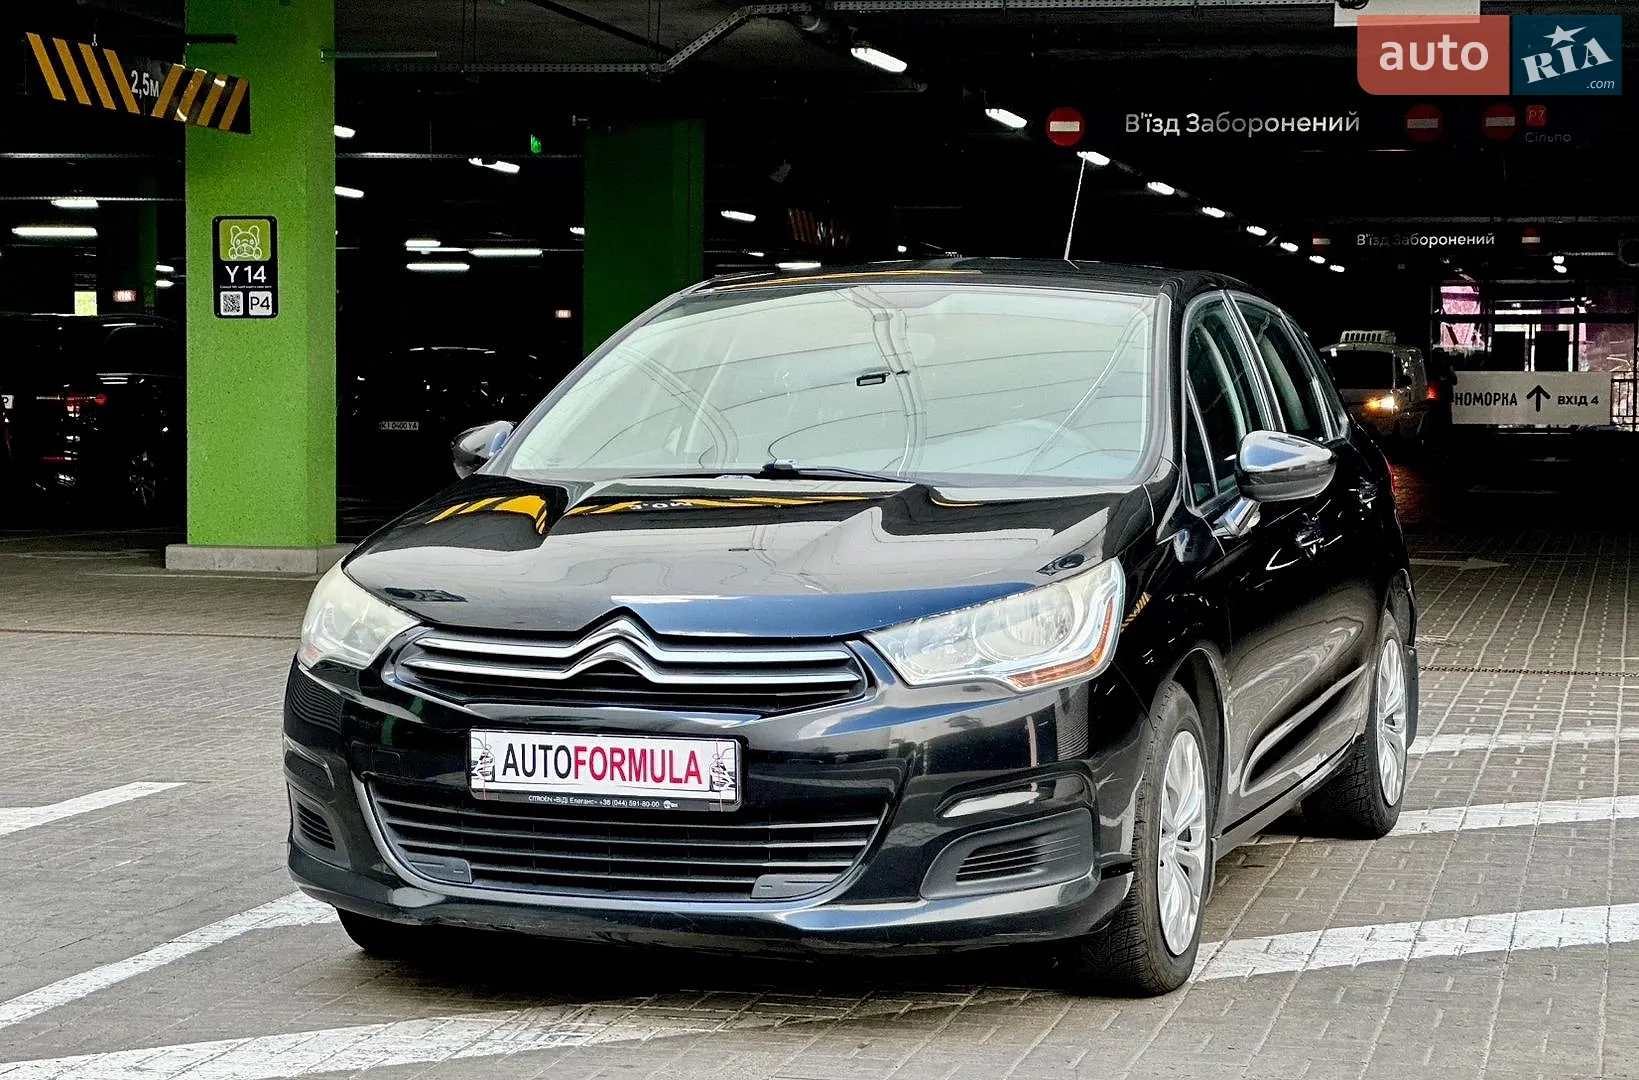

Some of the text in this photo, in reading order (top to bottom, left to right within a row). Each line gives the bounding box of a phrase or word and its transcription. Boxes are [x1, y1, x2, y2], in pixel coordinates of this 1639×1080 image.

[1125, 110, 1360, 138] В'їзд Заборонений
[1525, 132, 1572, 143] Сільпо
[1393, 232, 1495, 248] Заборонений
[225, 265, 266, 283] Y 14
[250, 296, 270, 310] P4
[1452, 392, 1518, 406] НОМОРКА
[1558, 395, 1599, 407] ВХІД 4
[502, 743, 703, 785] AUTOFORMULA
[611, 799, 628, 807] (044)
[628, 800, 660, 808] 591-80-00
